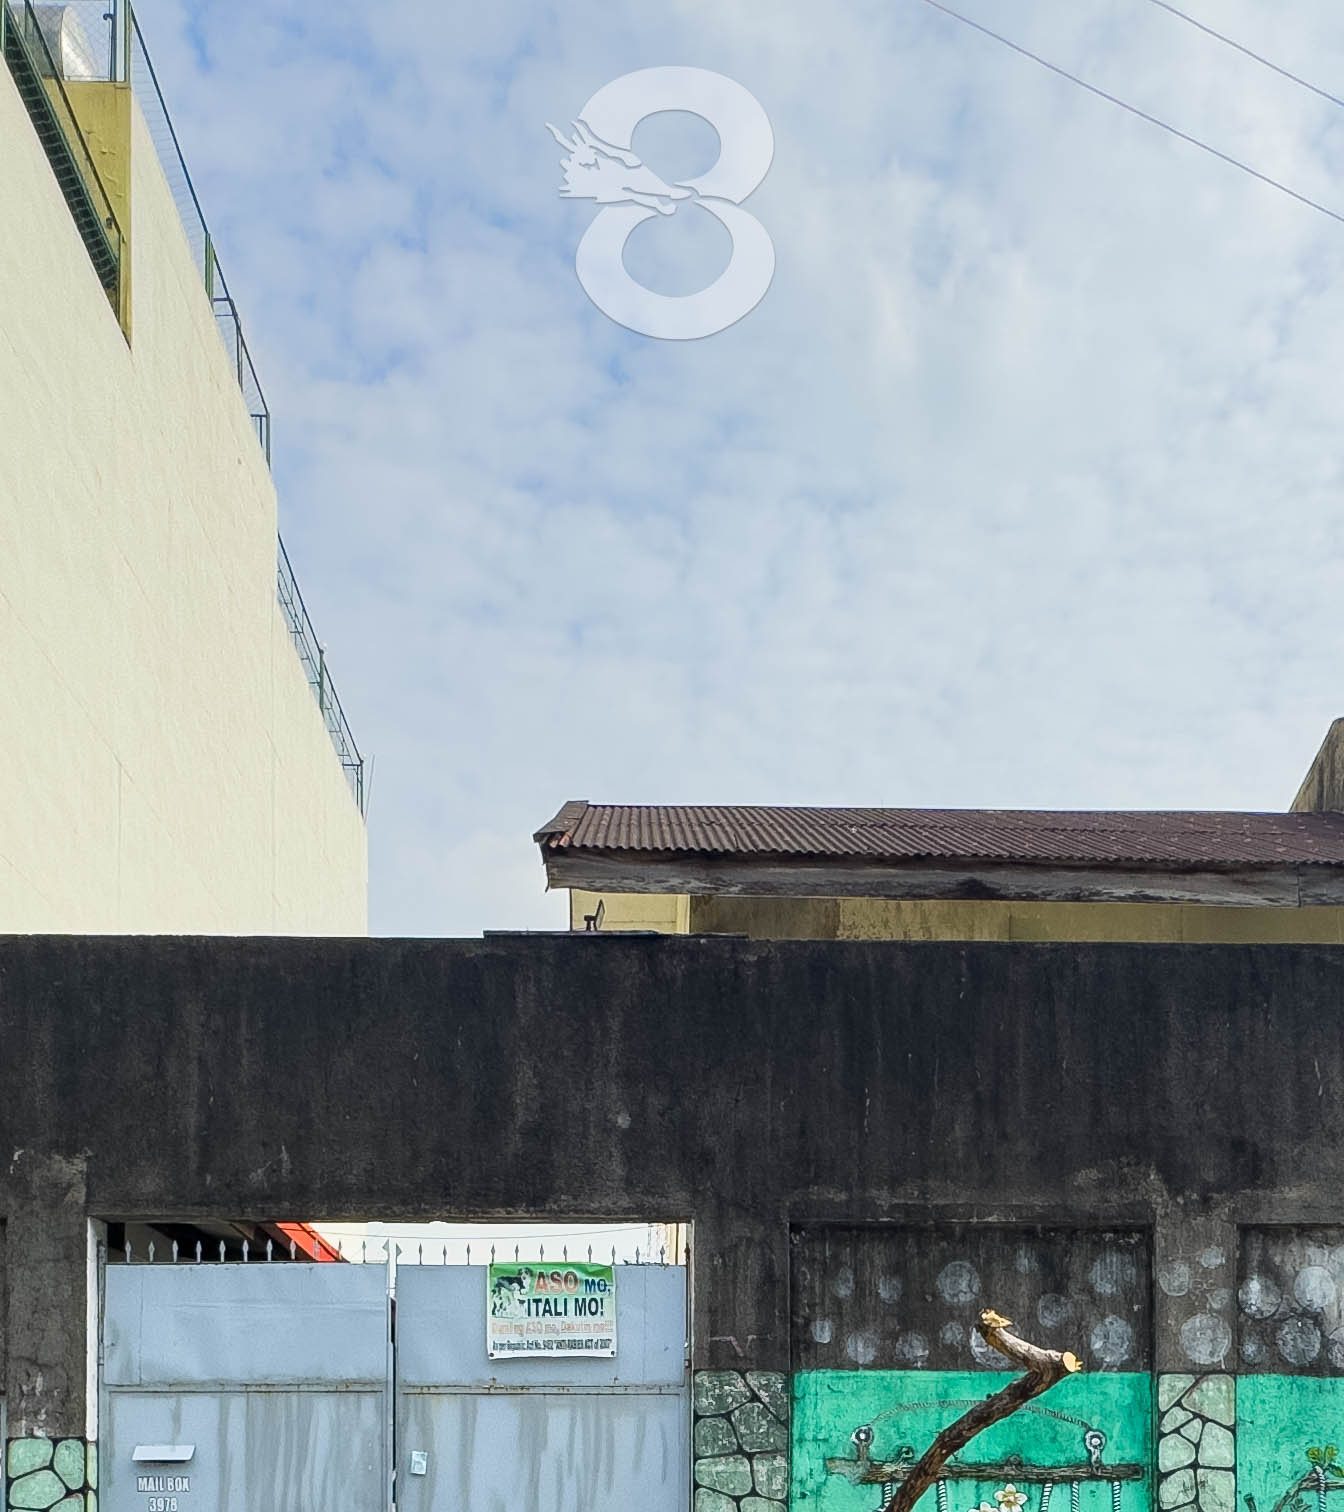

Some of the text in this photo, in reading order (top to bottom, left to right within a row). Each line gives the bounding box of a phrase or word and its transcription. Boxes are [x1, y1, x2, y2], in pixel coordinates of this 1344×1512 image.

[534, 1269, 579, 1294] ASO
[527, 1297, 604, 1317] ITALI MO!
[137, 1476, 190, 1492] MAIL BOX
[149, 1497, 177, 1512] 3978
